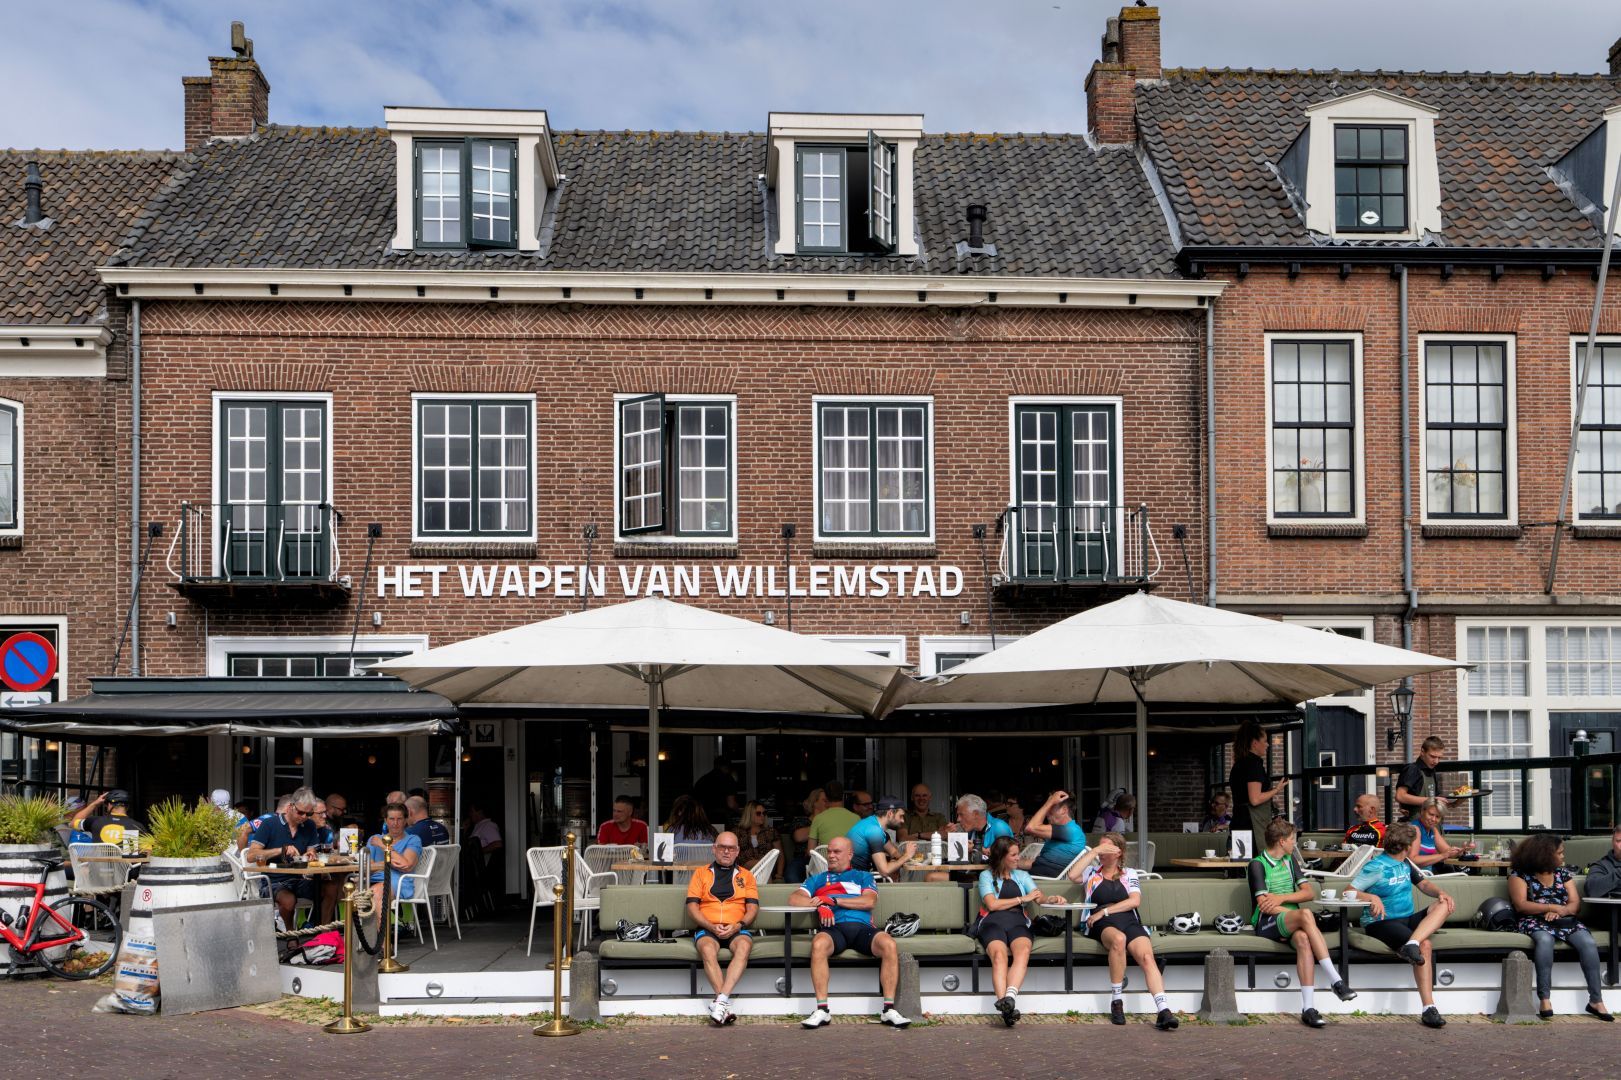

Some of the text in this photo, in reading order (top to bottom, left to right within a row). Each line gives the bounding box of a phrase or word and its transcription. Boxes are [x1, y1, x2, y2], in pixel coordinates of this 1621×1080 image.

[377, 565, 964, 597] HET WAPEN VAN WILLEMSTAD
